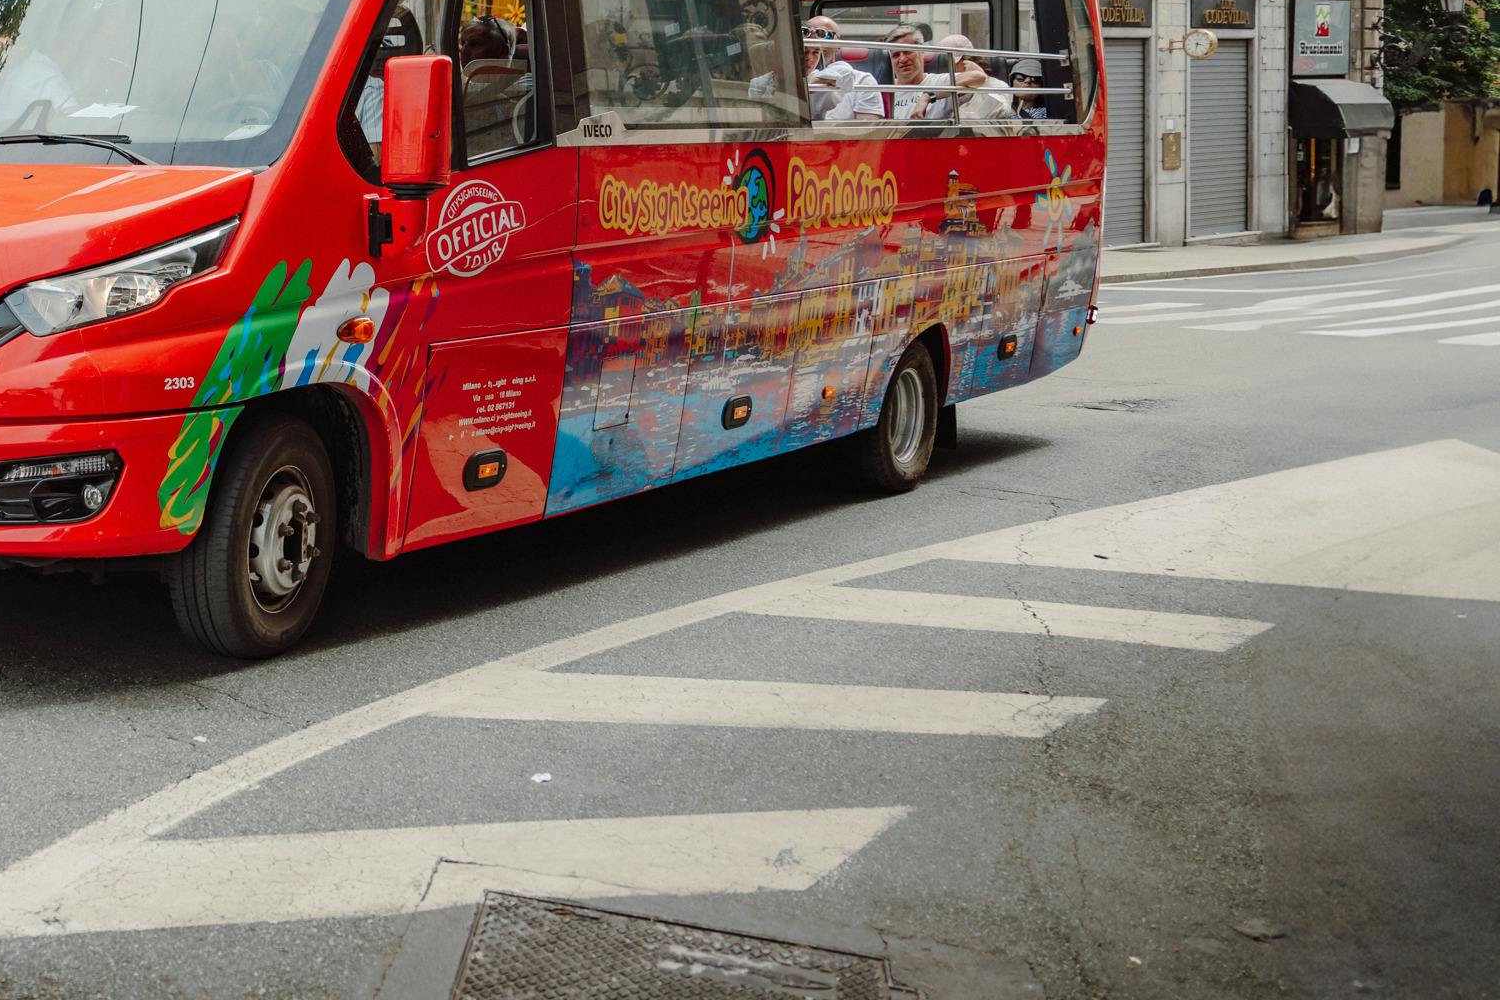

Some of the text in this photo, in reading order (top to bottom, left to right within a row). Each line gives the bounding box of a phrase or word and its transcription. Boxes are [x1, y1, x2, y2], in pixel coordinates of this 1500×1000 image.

[1204, 9, 1249, 24] CODEVILLA
[583, 124, 612, 138] IVECO
[447, 187, 498, 219] CITYSIGHTSEEING
[786, 156, 898, 229] Portofino
[437, 206, 520, 261] OFFICIAL
[464, 241, 502, 269] TOUR
[164, 376, 195, 391] 2303
